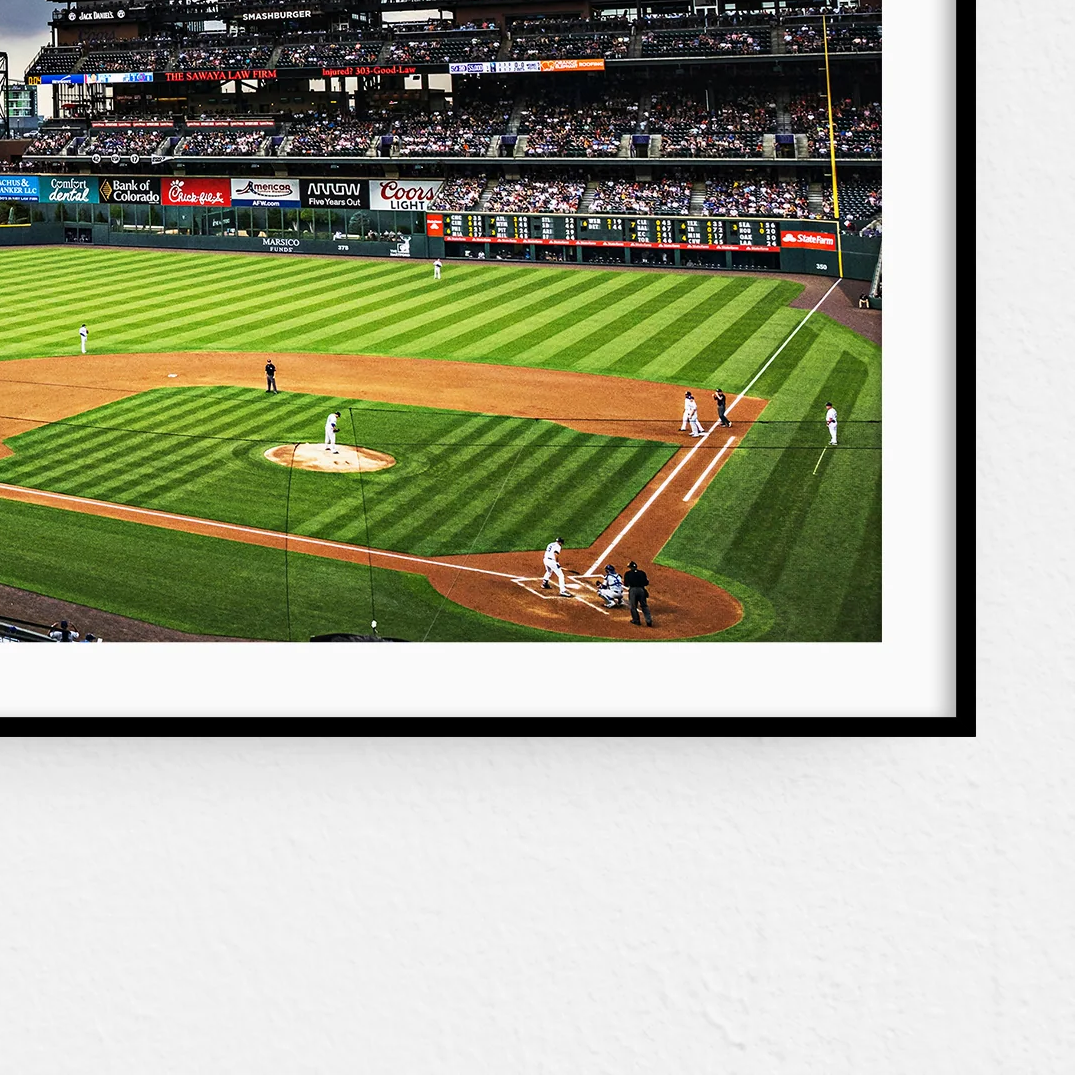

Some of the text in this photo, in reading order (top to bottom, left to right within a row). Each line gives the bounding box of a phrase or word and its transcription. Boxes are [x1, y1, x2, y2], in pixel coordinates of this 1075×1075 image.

[78, 10, 114, 21] JACK DANIEL'S
[242, 10, 312, 21] SMASHBURGER
[165, 69, 277, 82] THE SAWAYA LAW FIRM
[322, 66, 416, 77] Injured? 303-Good-Law
[28, 77, 41, 86] 0:04
[21, 178, 30, 187] &
[51, 178, 87, 189] Comfort
[113, 179, 151, 191] Bank of
[24, 186, 38, 194] LLC
[49, 188, 90, 202] dental
[380, 181, 434, 201] Coors
[113, 190, 160, 202] Colorado
[308, 198, 361, 206] Five Years Out
[390, 201, 425, 210] LIGHT
[262, 238, 300, 247] MARSICO
[815, 263, 828, 271] 350
